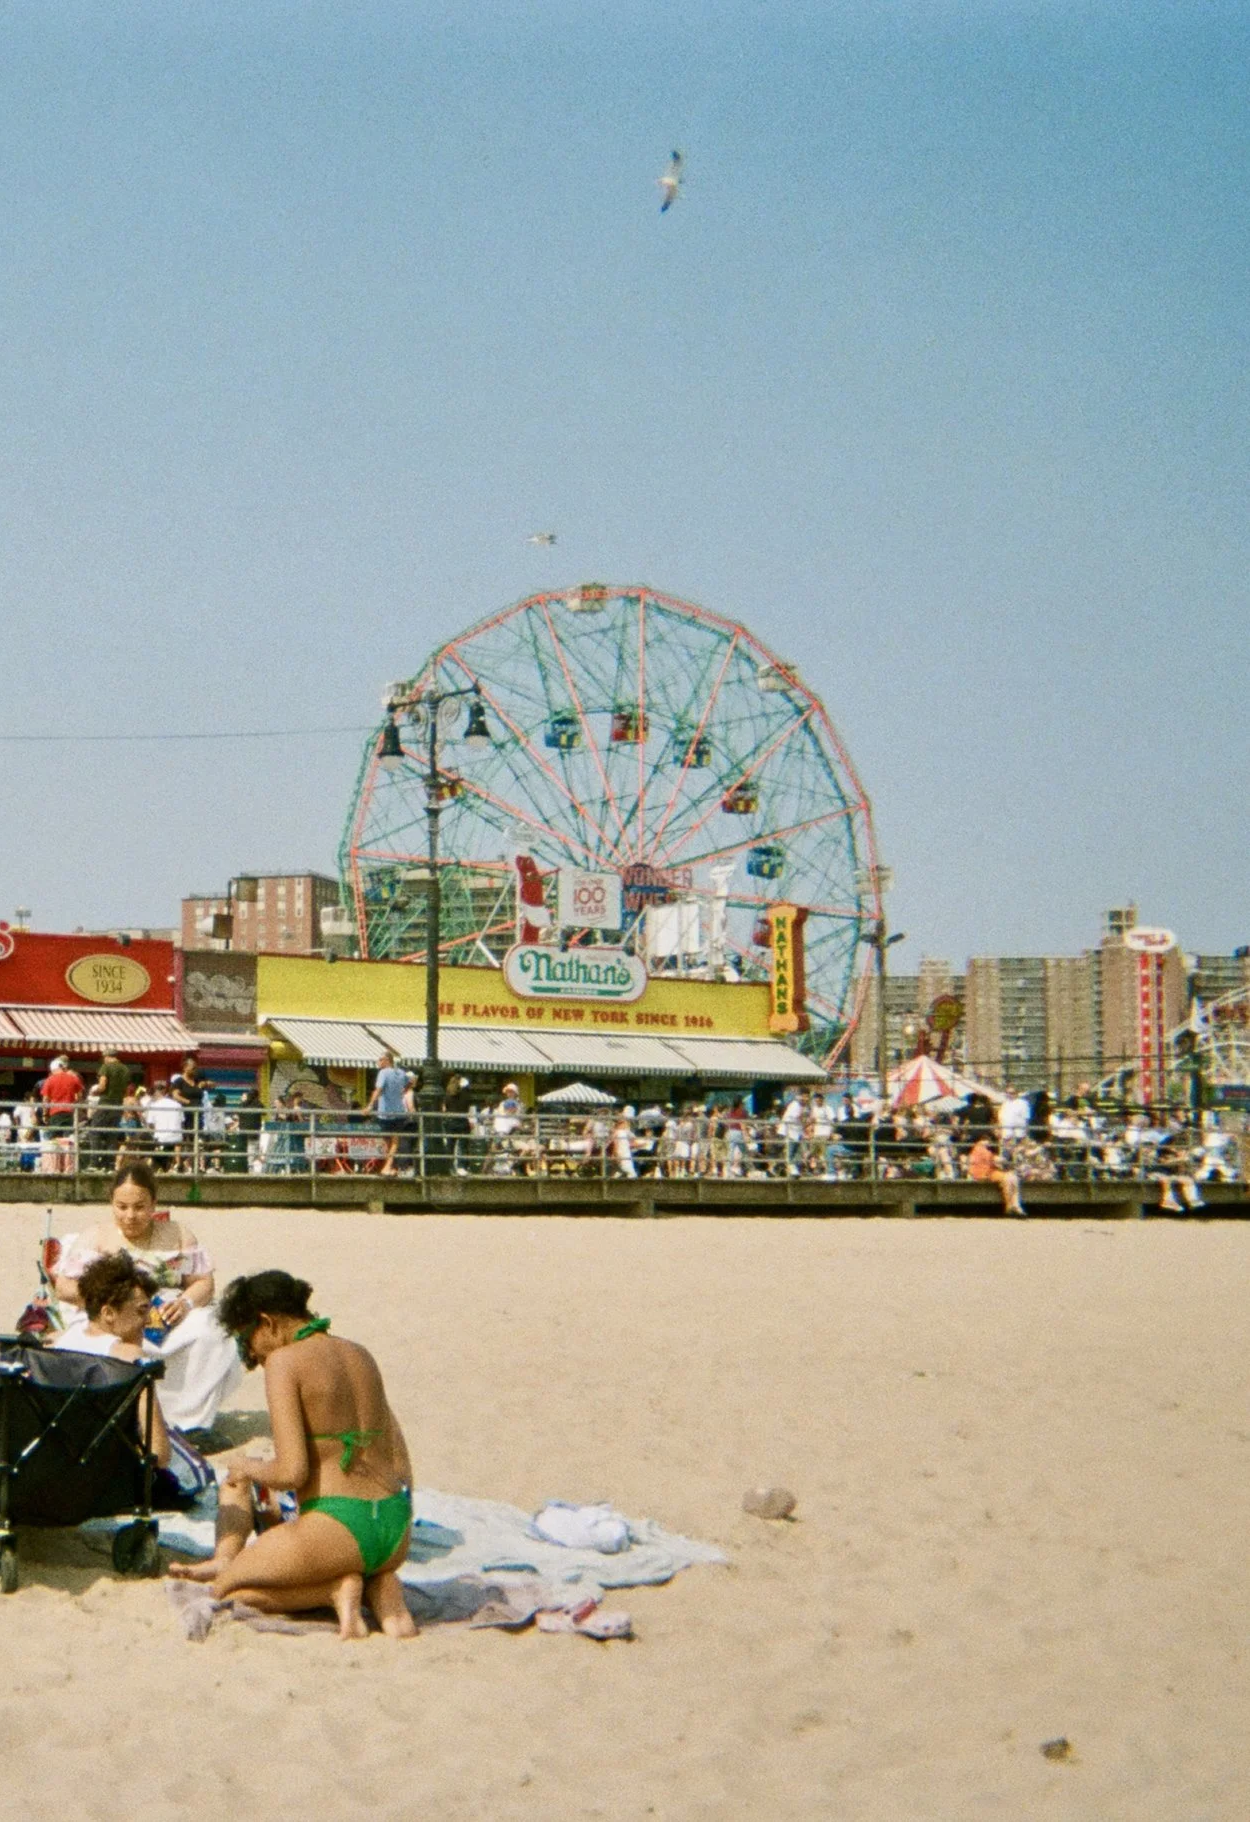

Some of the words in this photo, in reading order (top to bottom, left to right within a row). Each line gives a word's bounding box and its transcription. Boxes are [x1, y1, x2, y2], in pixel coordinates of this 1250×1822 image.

[573, 886, 606, 904] 100
[573, 905, 606, 917] YEARS
[92, 964, 126, 979] SINCE
[519, 950, 632, 986] Nathan's
[776, 916, 789, 1015] NATHANS
[96, 980, 122, 994] 1934
[437, 1002, 454, 1016] HE
[462, 1003, 520, 1019] FLAVOR
[526, 1007, 544, 1020] OF
[552, 1008, 584, 1022] NEW
[591, 1010, 628, 1024] YORK
[635, 1012, 677, 1026] SINCE
